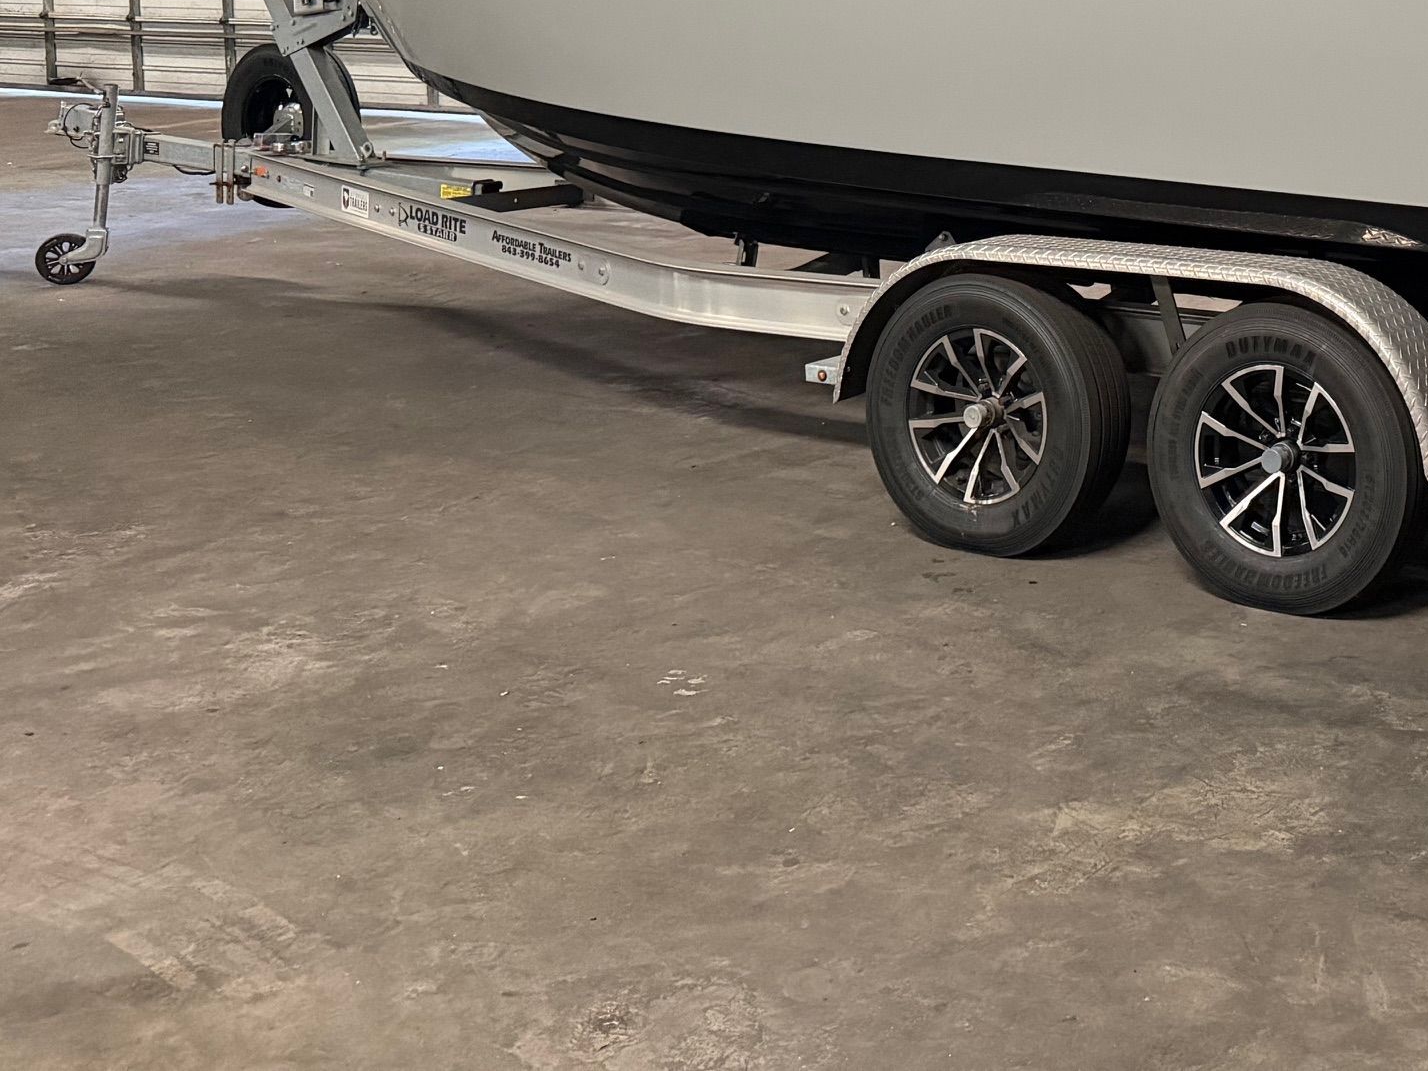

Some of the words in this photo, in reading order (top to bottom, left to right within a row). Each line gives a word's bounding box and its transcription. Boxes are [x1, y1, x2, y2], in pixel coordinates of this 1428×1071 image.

[409, 205, 439, 226] LOAD
[441, 214, 467, 235] RITE
[1225, 335, 1318, 368] DUTYMAX
